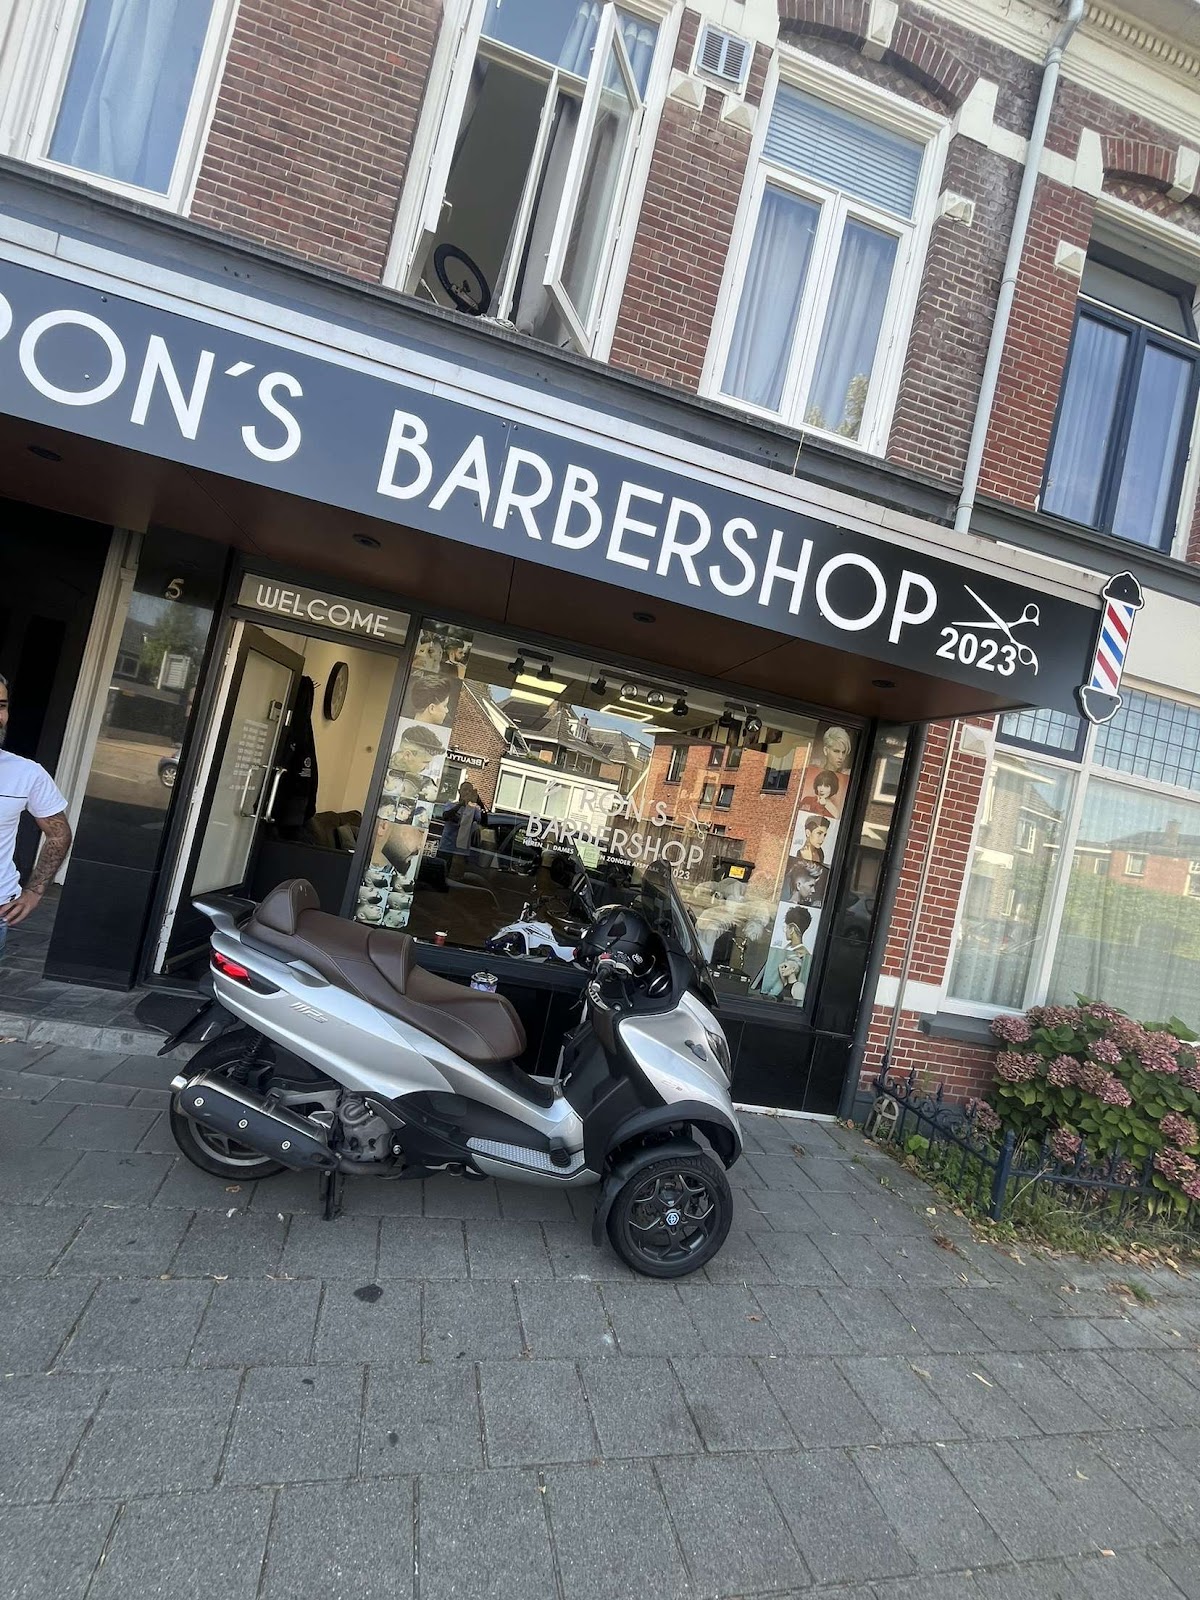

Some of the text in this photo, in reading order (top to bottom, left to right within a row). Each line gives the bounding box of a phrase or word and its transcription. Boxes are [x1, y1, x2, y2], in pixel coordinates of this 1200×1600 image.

[0, 292, 938, 644] ON'S BARBERSHOP
[165, 578, 184, 599] 5
[255, 584, 389, 637] WELCOME
[935, 627, 1017, 676] 2023
[525, 811, 704, 870] BARBERSHOP
[552, 844, 574, 855] DAMES
[606, 854, 632, 867] ZONDER
